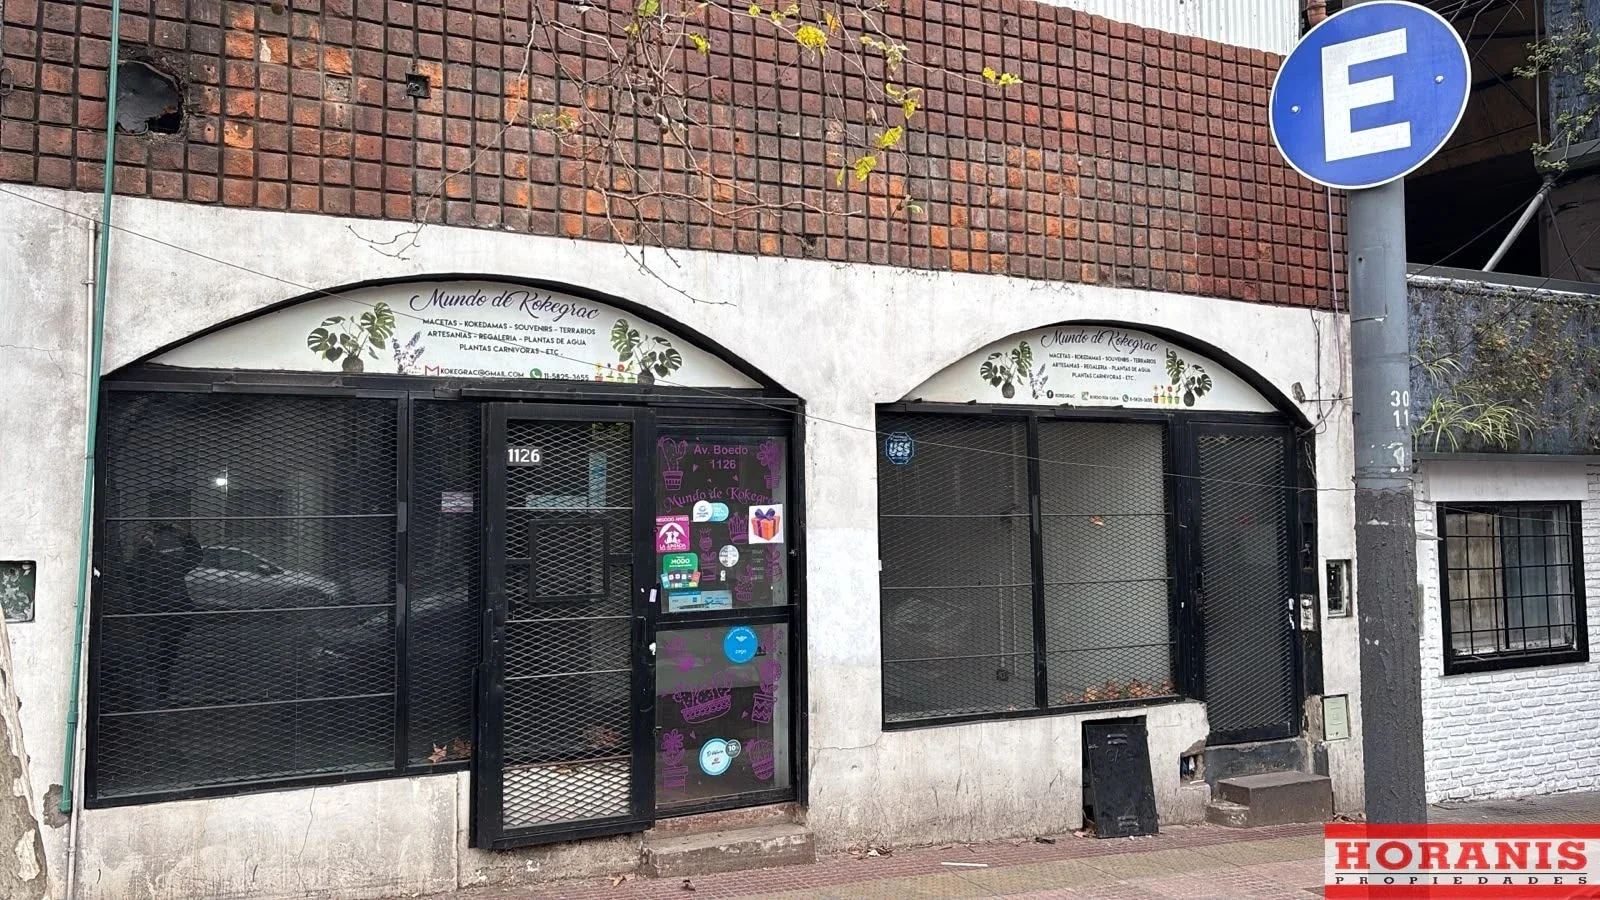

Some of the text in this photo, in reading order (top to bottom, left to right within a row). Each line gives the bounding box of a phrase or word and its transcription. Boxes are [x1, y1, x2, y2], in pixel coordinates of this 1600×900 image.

[1321, 27, 1412, 162] E
[409, 288, 600, 322] Mundo de Kokegrac
[422, 318, 457, 327] MACETAS
[464, 320, 508, 329] KOKEDAMAS
[514, 323, 553, 332] SOUVENIRS
[559, 326, 596, 335] TERRARIOS
[427, 330, 472, 339] ARTESANIAS
[478, 332, 517, 342] REGALERIA
[524, 335, 555, 344] PLANTAS
[556, 337, 565, 345] DE
[566, 338, 587, 346] AGUA
[1041, 329, 1159, 354] Mundo de Kokegrac
[459, 343, 492, 352] PLANTAS
[493, 345, 540, 354] CARNIVORAS
[1049, 352, 1071, 360] MACETAS
[1133, 357, 1157, 365] TERRARIOS
[1390, 390, 1409, 407] 30
[1393, 408, 1409, 430] 11
[507, 447, 541, 463] 1126
[693, 444, 749, 455] Av. Boedo
[710, 459, 737, 470] 1126
[663, 487, 707, 513] Mundo
[709, 486, 722, 499] de
